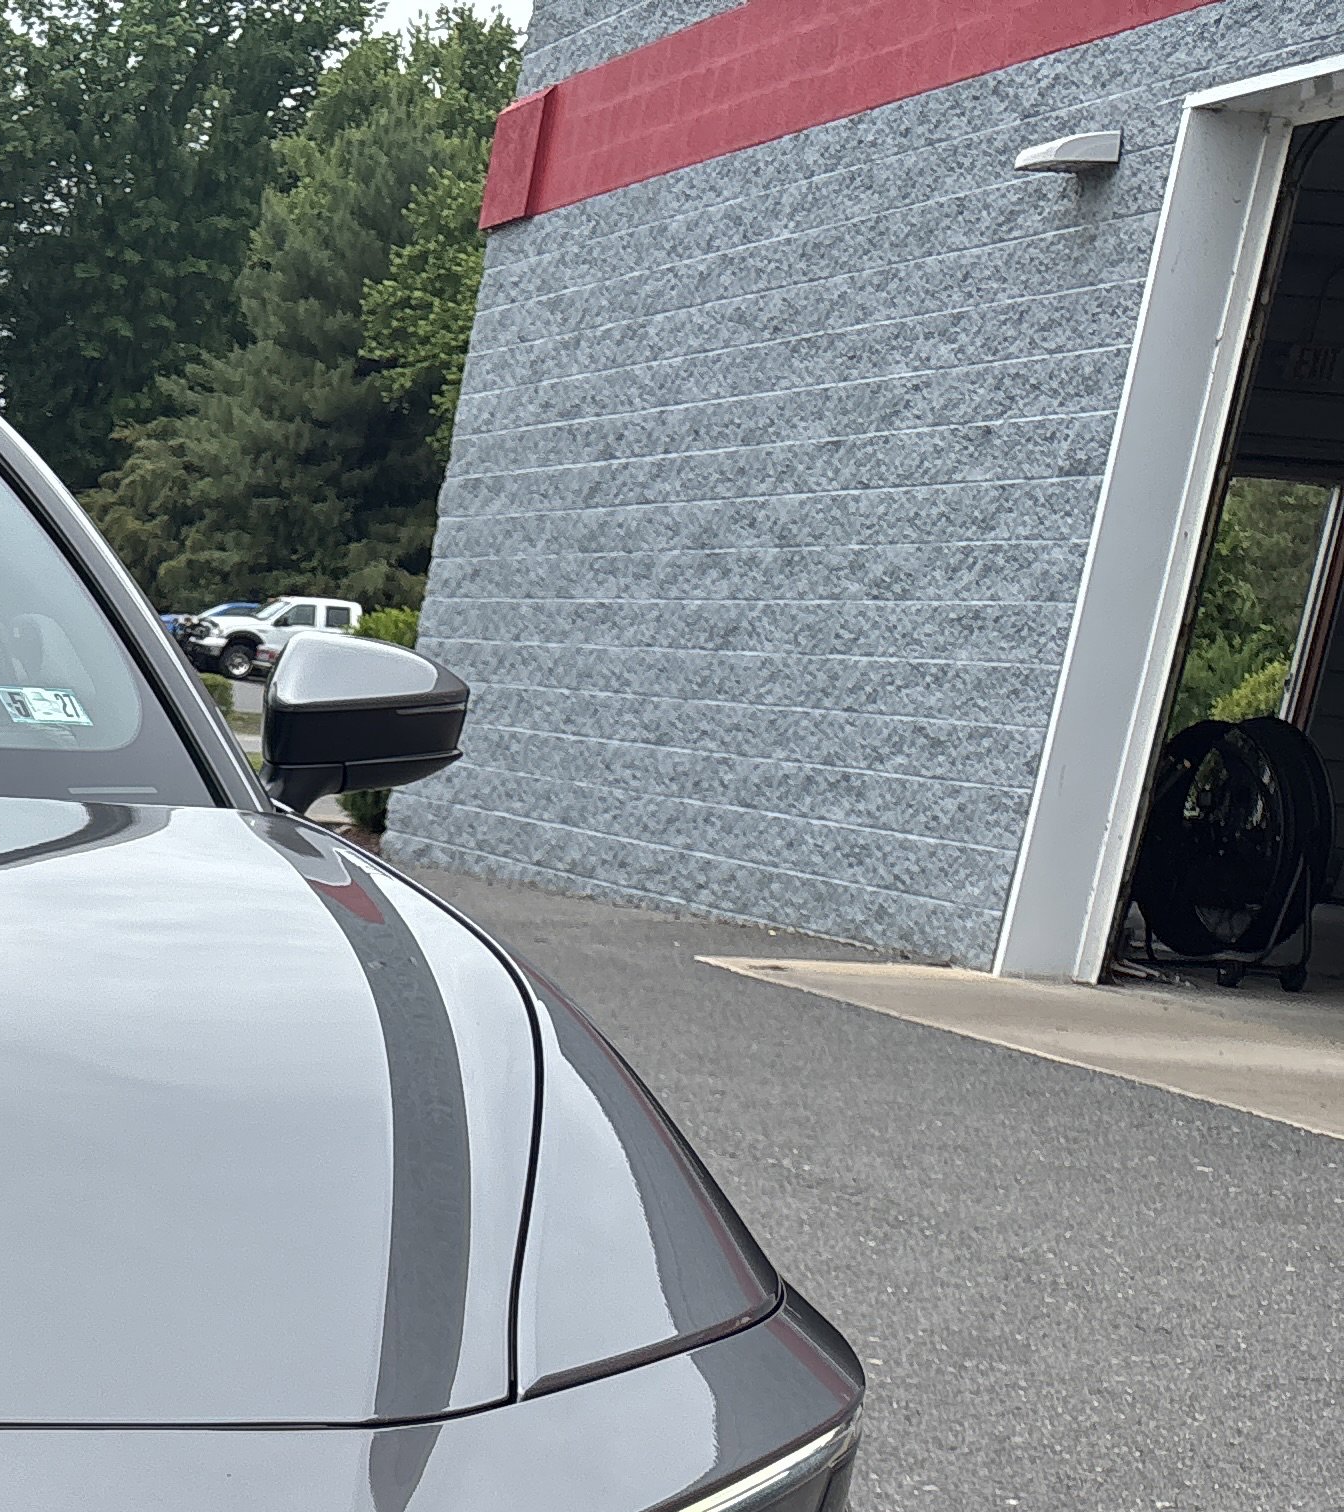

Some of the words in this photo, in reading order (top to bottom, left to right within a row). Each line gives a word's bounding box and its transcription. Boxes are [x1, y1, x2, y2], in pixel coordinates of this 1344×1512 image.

[1293, 347, 1339, 380] EXIT
[7, 691, 30, 718] 5
[54, 693, 80, 718] 27
